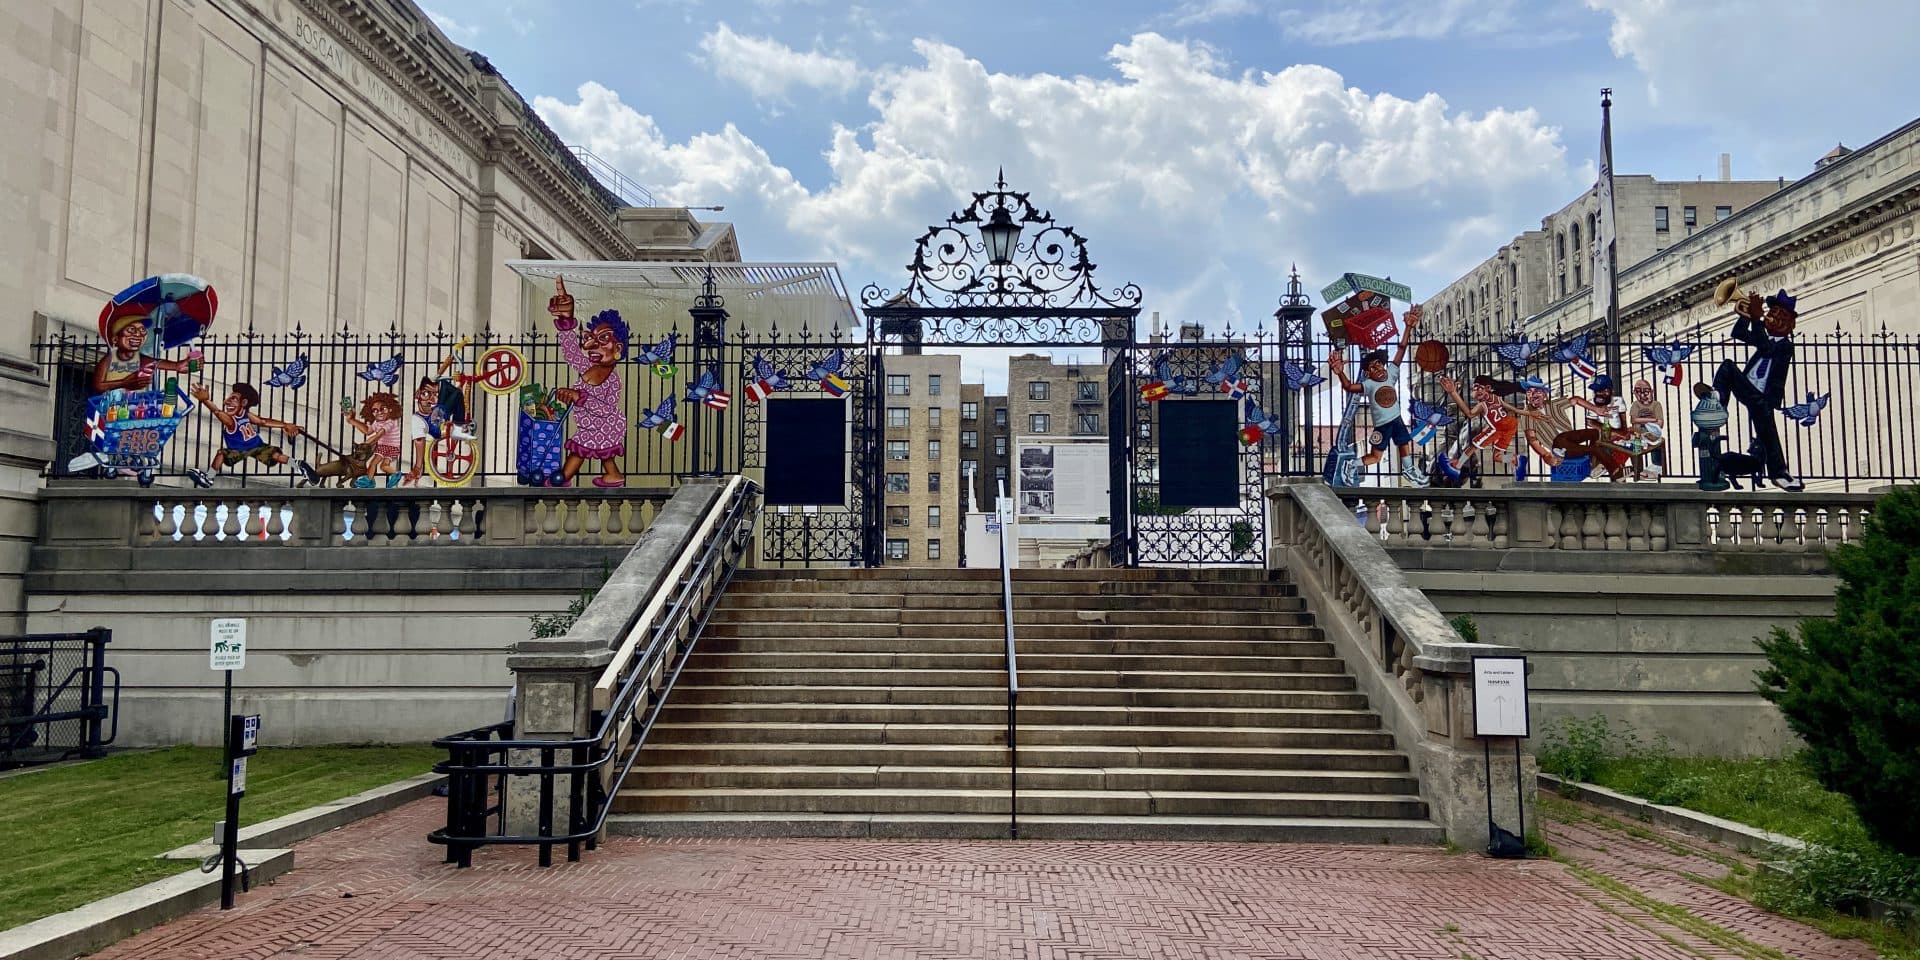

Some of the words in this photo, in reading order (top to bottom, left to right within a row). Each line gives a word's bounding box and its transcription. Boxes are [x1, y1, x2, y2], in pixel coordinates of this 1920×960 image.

[296, 16, 343, 70] BOSCAN
[1358, 277, 1409, 299] BROADWAY
[1763, 274, 1787, 293] SOTO
[1490, 406, 1507, 422] 26
[121, 429, 160, 441] FRIO
[239, 422, 257, 441] 11
[119, 441, 160, 454] FRIO
